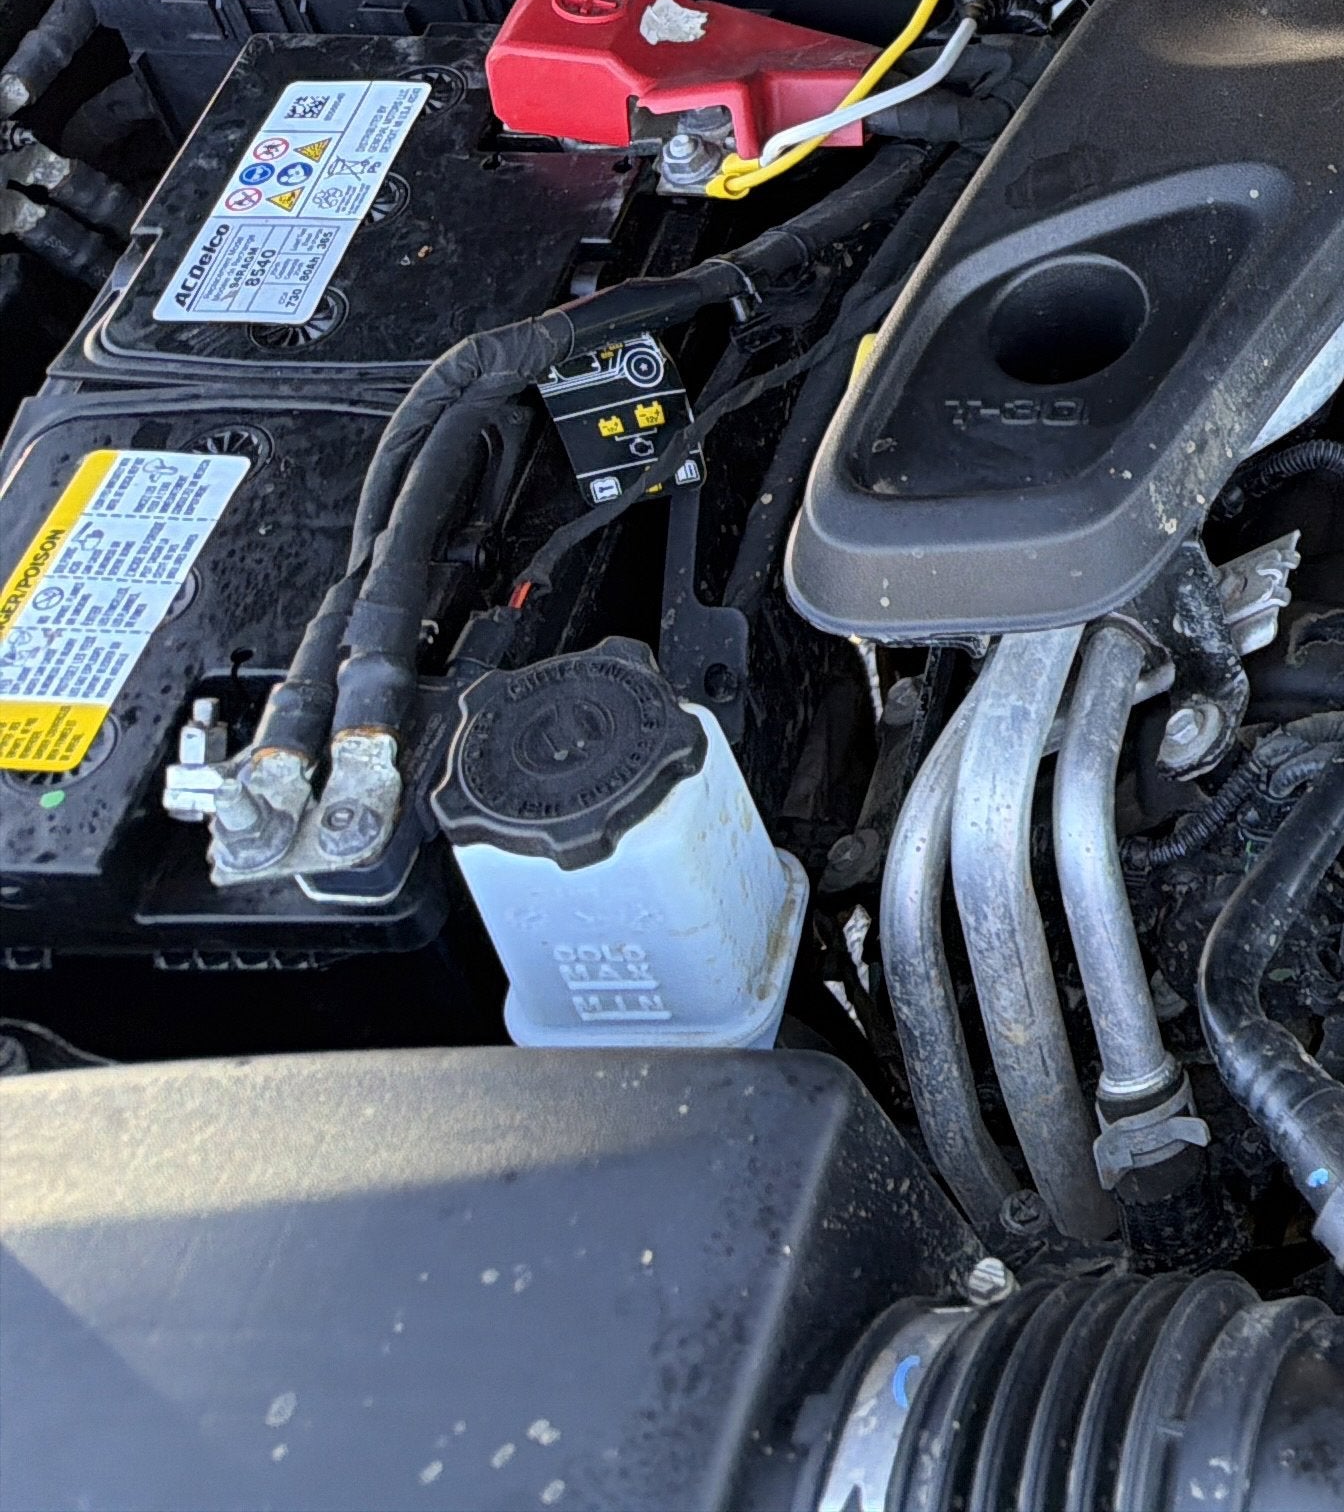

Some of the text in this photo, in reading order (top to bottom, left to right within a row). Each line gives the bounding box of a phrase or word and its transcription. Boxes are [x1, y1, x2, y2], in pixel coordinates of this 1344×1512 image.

[174, 224, 230, 308] ACDelco
[244, 249, 277, 286] 8540
[298, 256, 321, 281] 80Ah
[285, 288, 304, 307] 730
[0, 529, 66, 629] GER/POISON
[553, 943, 647, 962] COLD
[559, 962, 654, 981] MAX
[572, 994, 665, 1012] MIN
